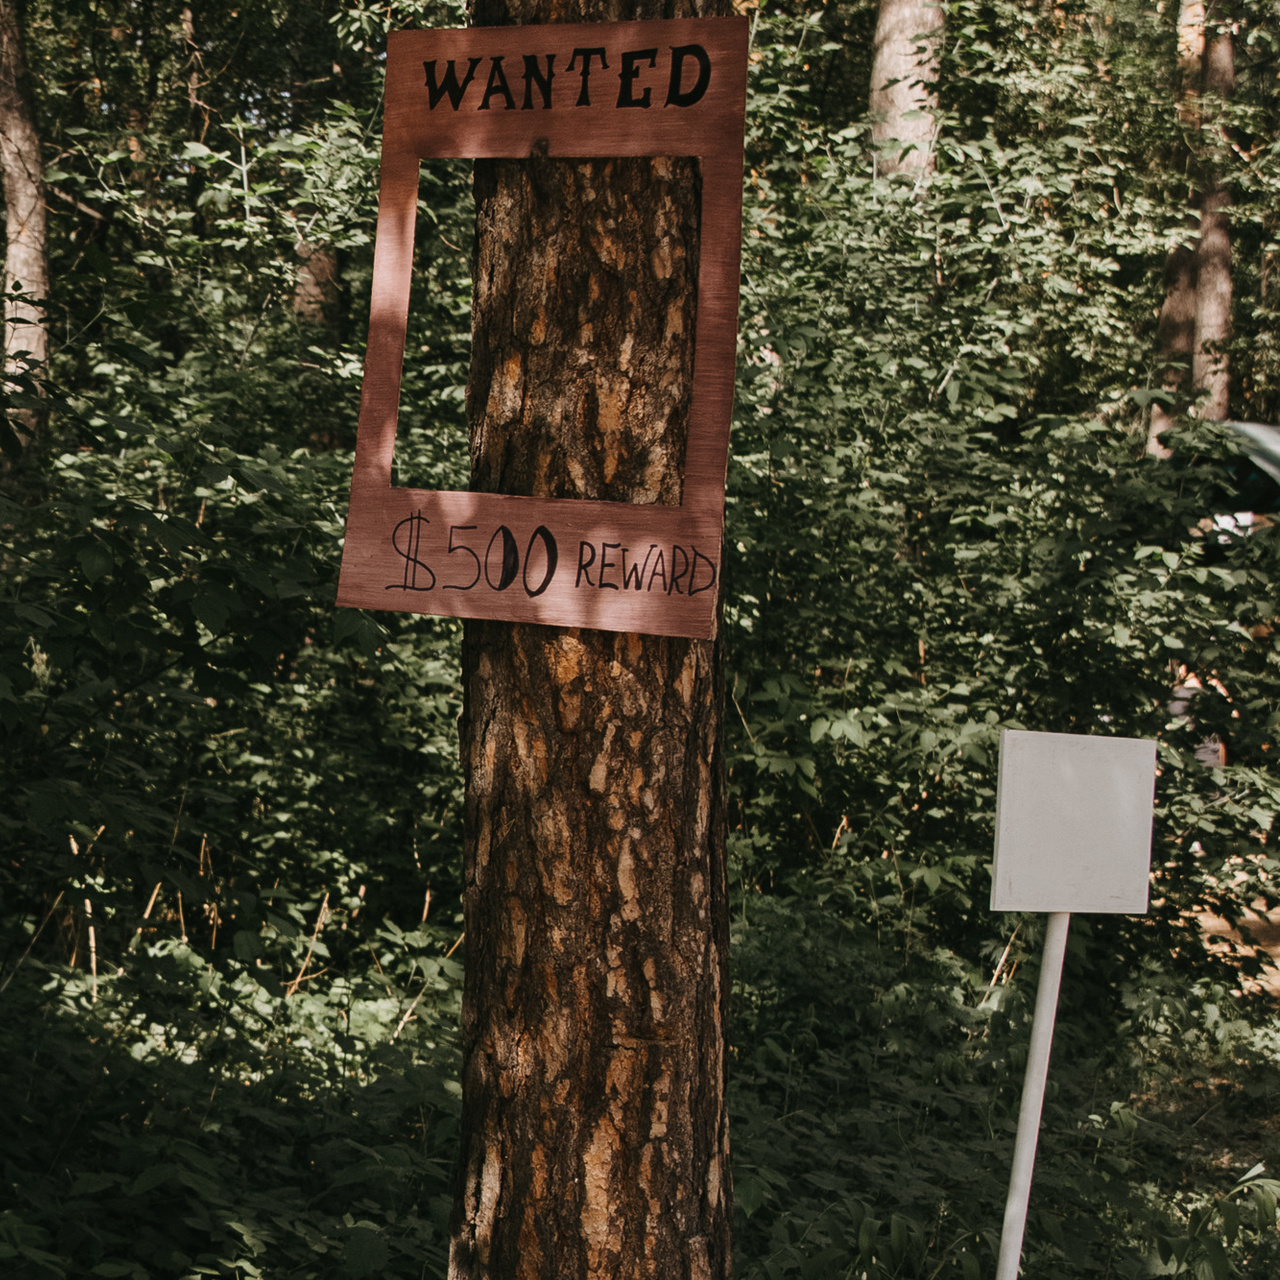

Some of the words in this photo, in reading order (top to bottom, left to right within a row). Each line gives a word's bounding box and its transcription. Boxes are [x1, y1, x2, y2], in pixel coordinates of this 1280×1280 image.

[422, 44, 712, 111] WANTED
[385, 509, 559, 598] $500
[574, 540, 717, 597] REWARD
